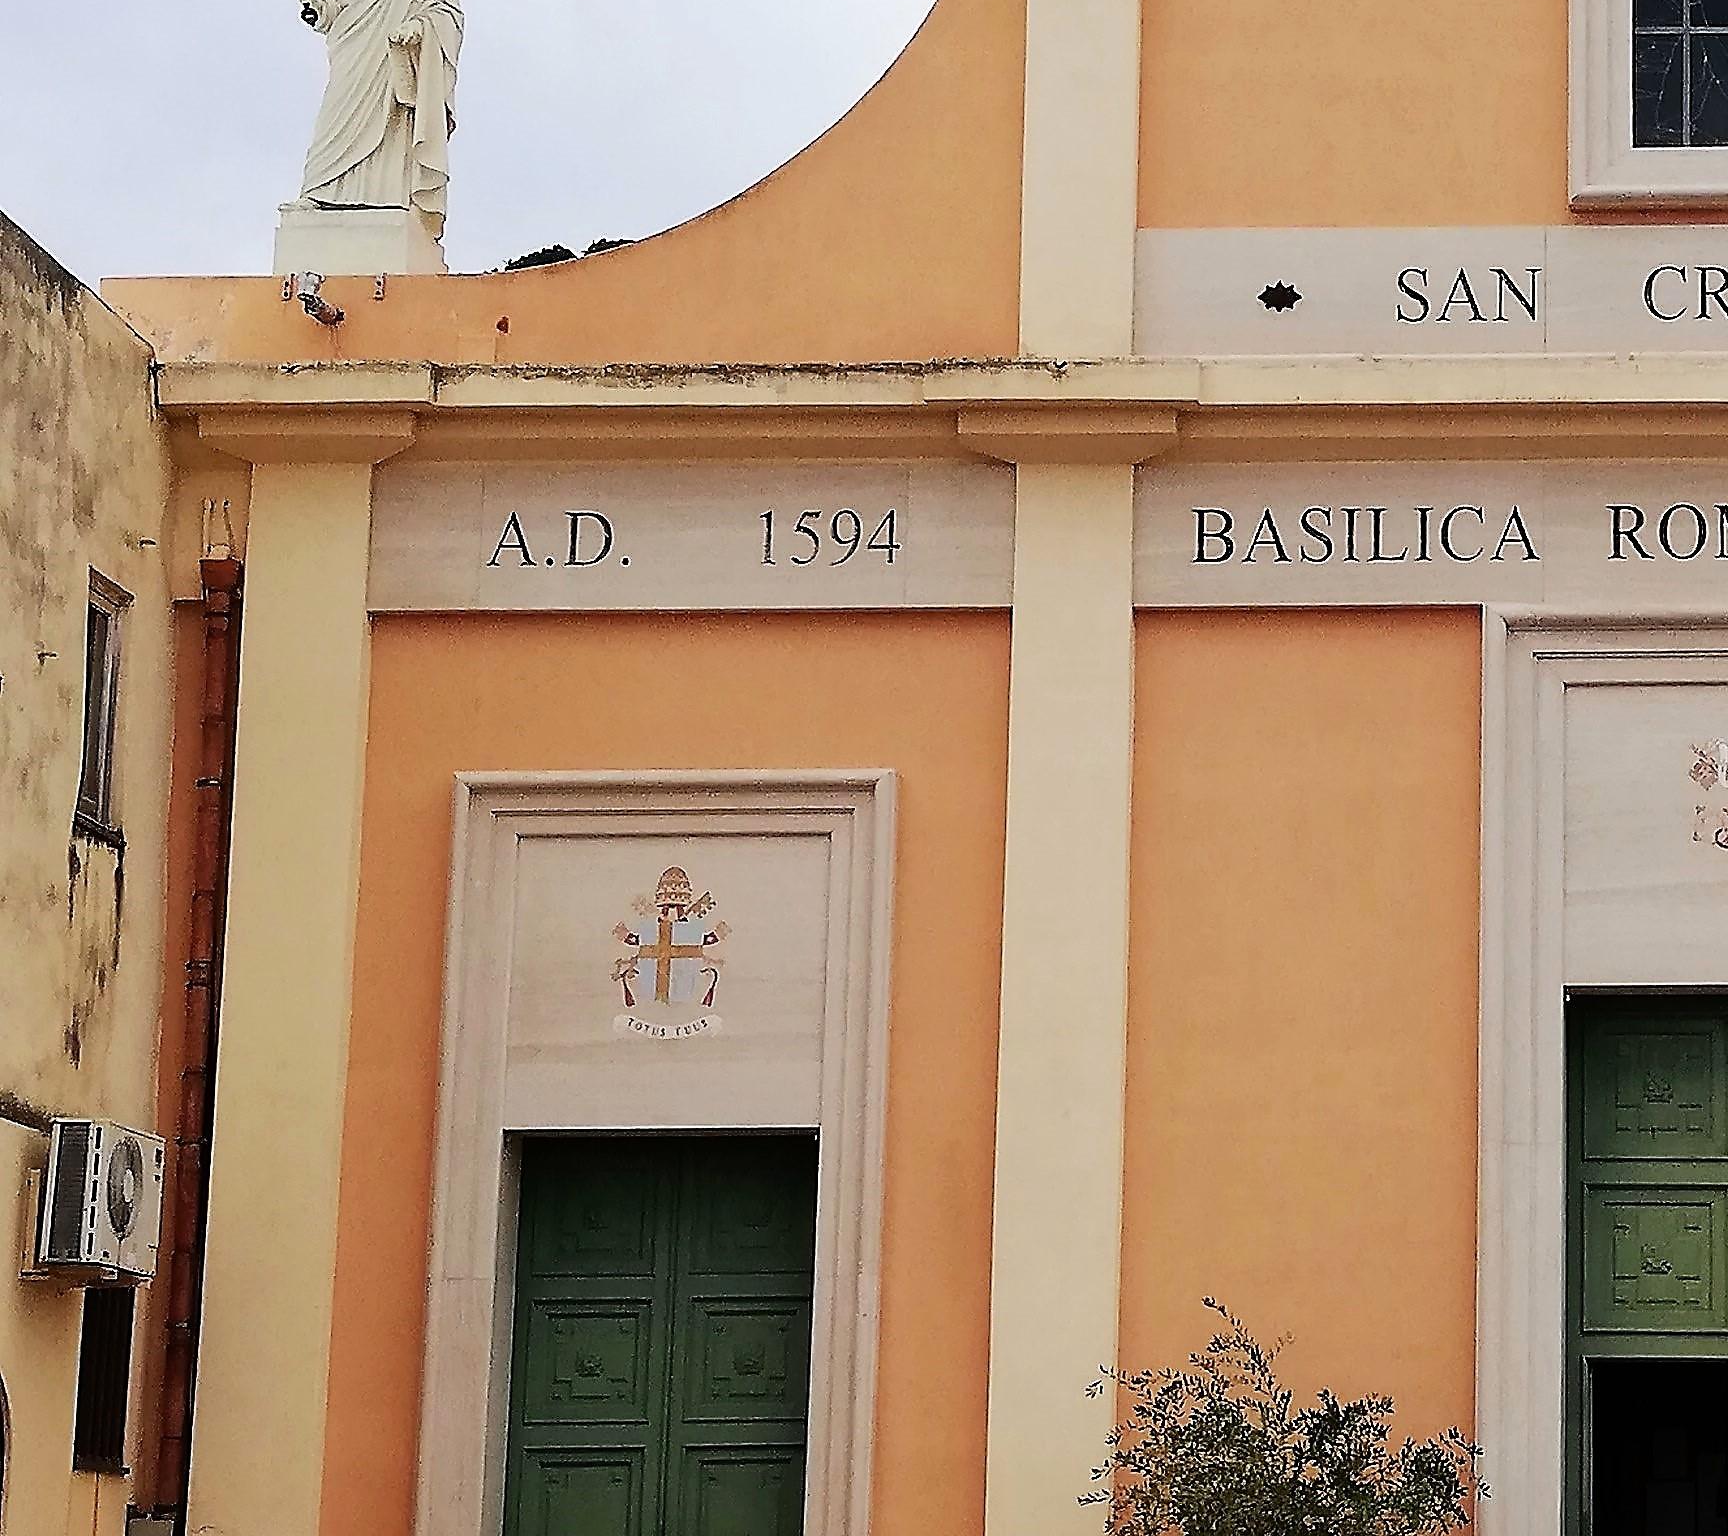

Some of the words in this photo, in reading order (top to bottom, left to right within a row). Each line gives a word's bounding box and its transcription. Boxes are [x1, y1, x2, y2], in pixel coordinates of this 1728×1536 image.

[1396, 267, 1541, 324] SAN
[486, 511, 631, 567] A.D.
[759, 509, 901, 567] 1594
[1191, 505, 1541, 565] BASILICA
